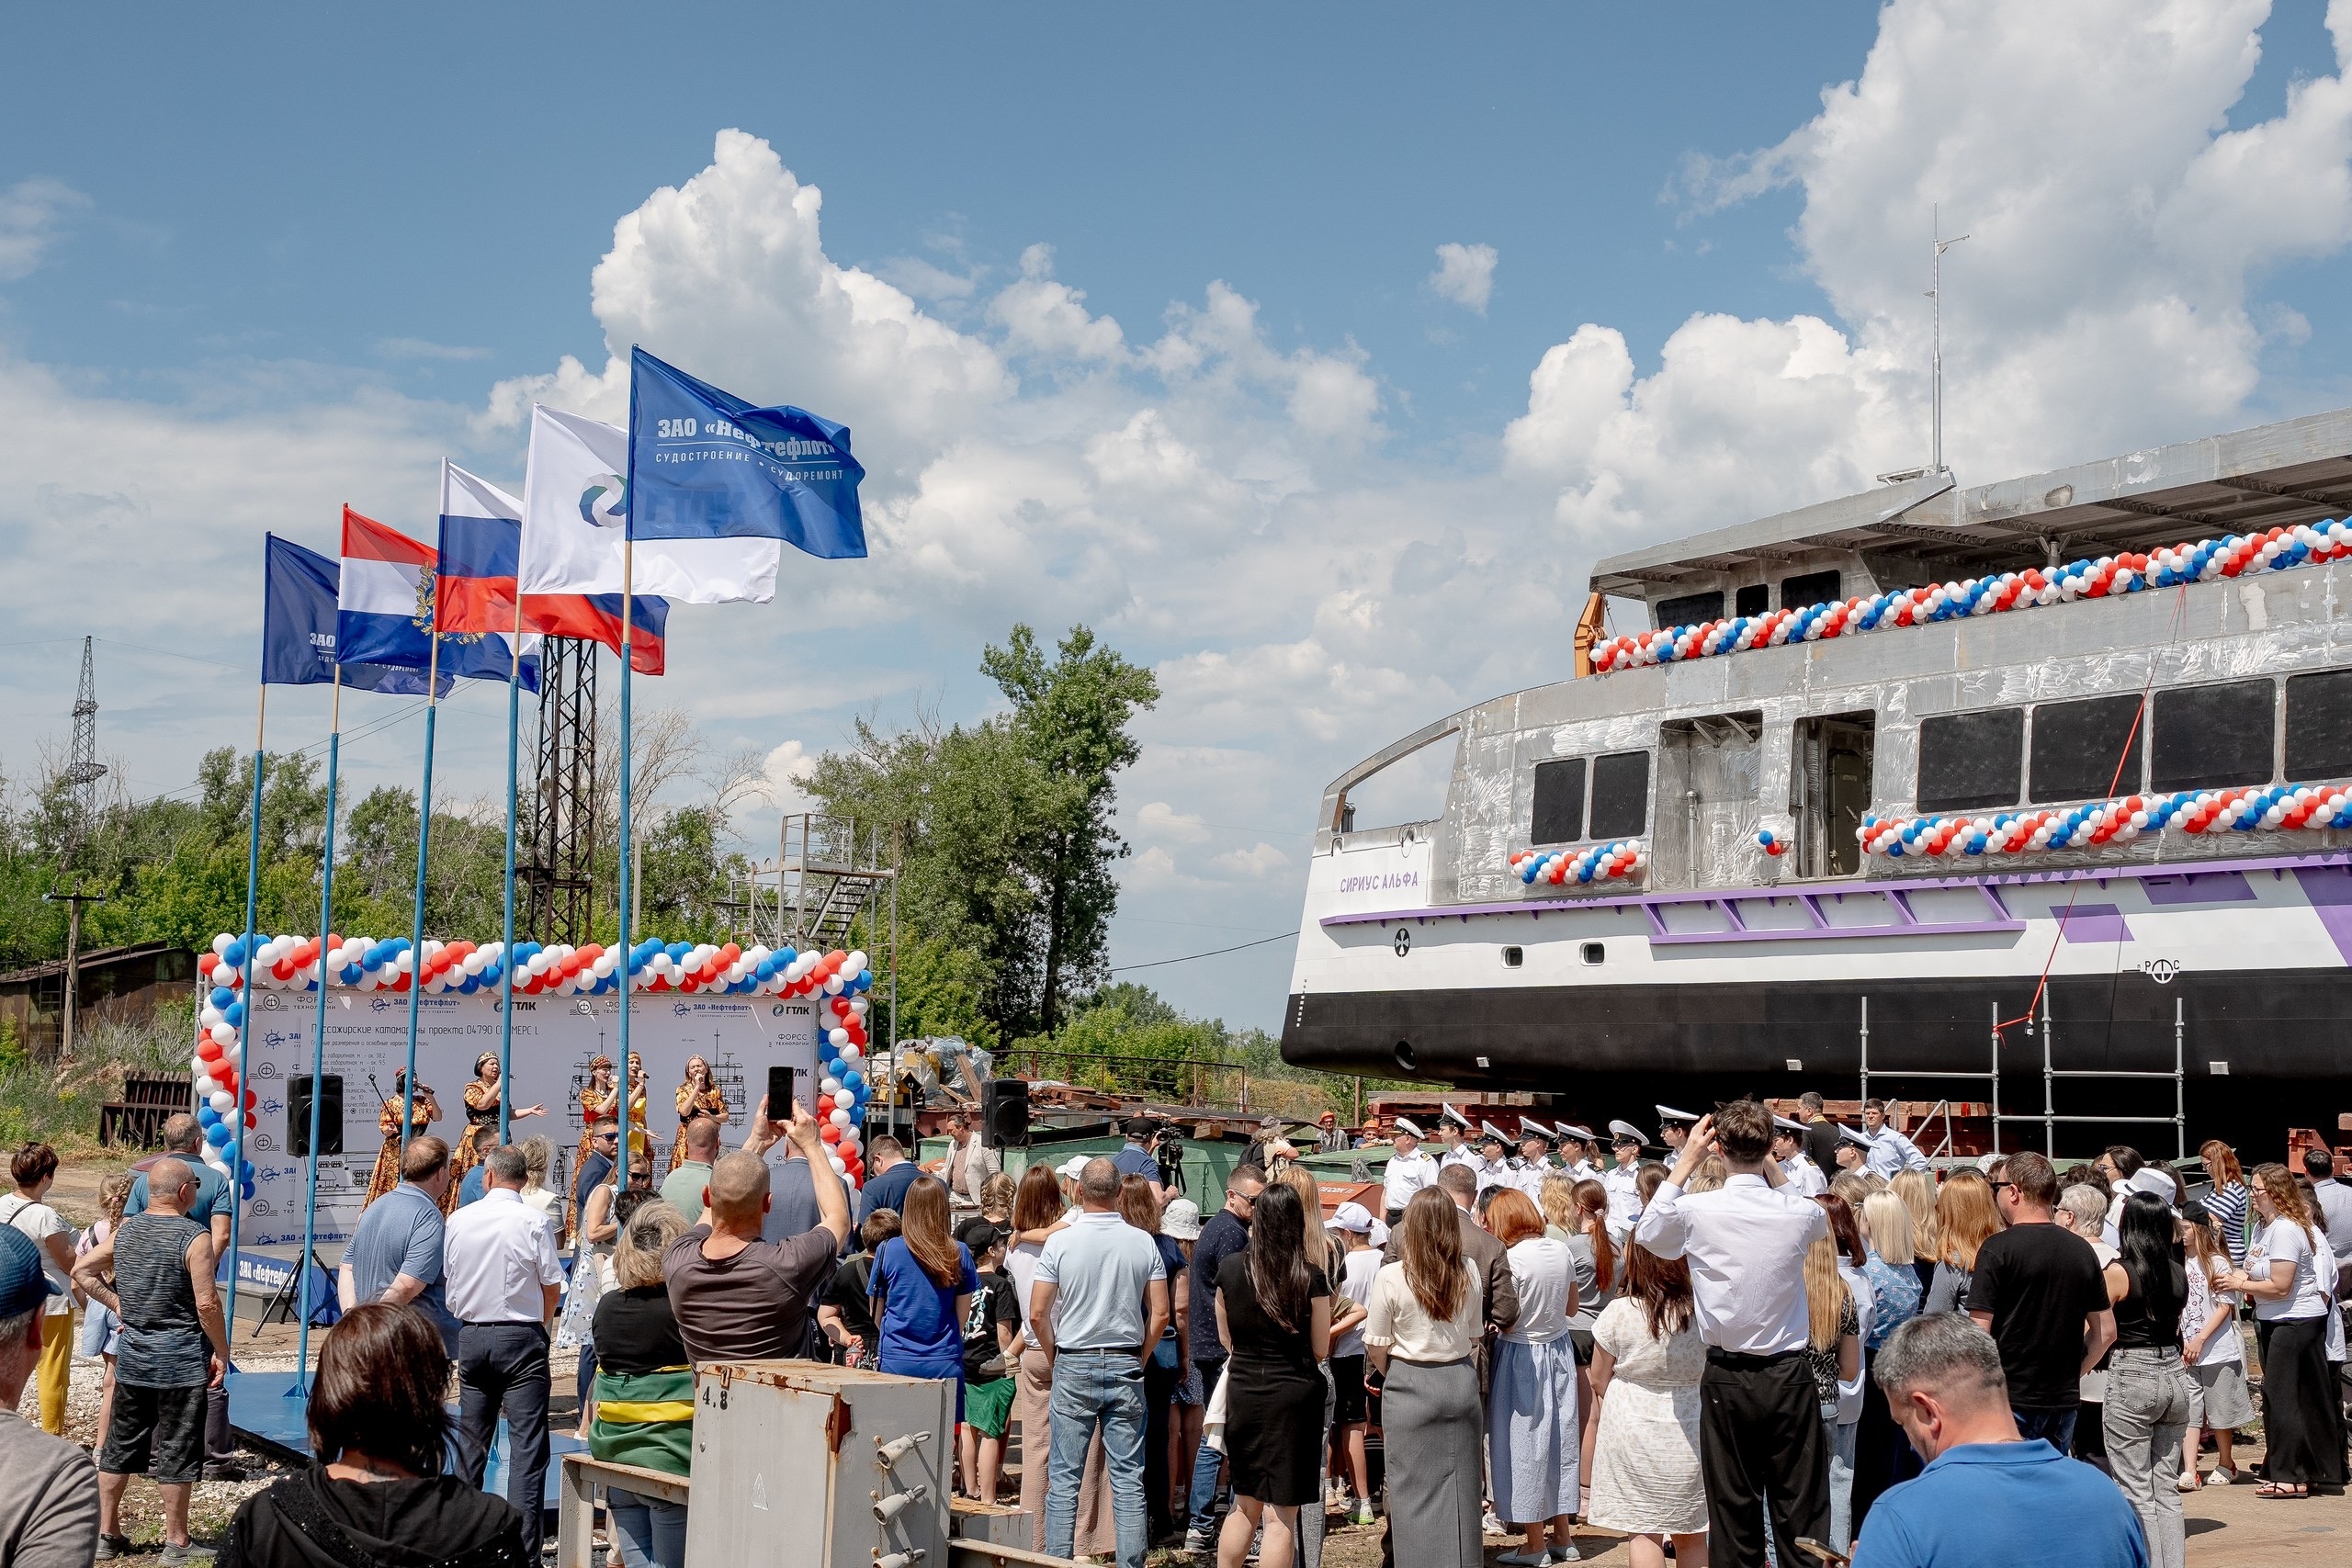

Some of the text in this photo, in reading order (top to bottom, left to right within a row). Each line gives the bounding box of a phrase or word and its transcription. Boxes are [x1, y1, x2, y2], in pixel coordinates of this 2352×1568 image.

[658, 418, 697, 438] ЗАО
[656, 450, 843, 481] СУДОСТРОЕНИЕ СУДОРЕМОНТ
[310, 632, 335, 648] ЗАО
[1340, 871, 1418, 893] СИРИУС АЛЬФА
[512, 1001, 536, 1010] ТЛК
[786, 1006, 809, 1014] ГТЛК
[429, 1026, 463, 1036] проекта
[467, 1024, 492, 1035] 04790
[280, 1234, 296, 1242] ЗАО
[240, 1260, 252, 1279] ЗАО
